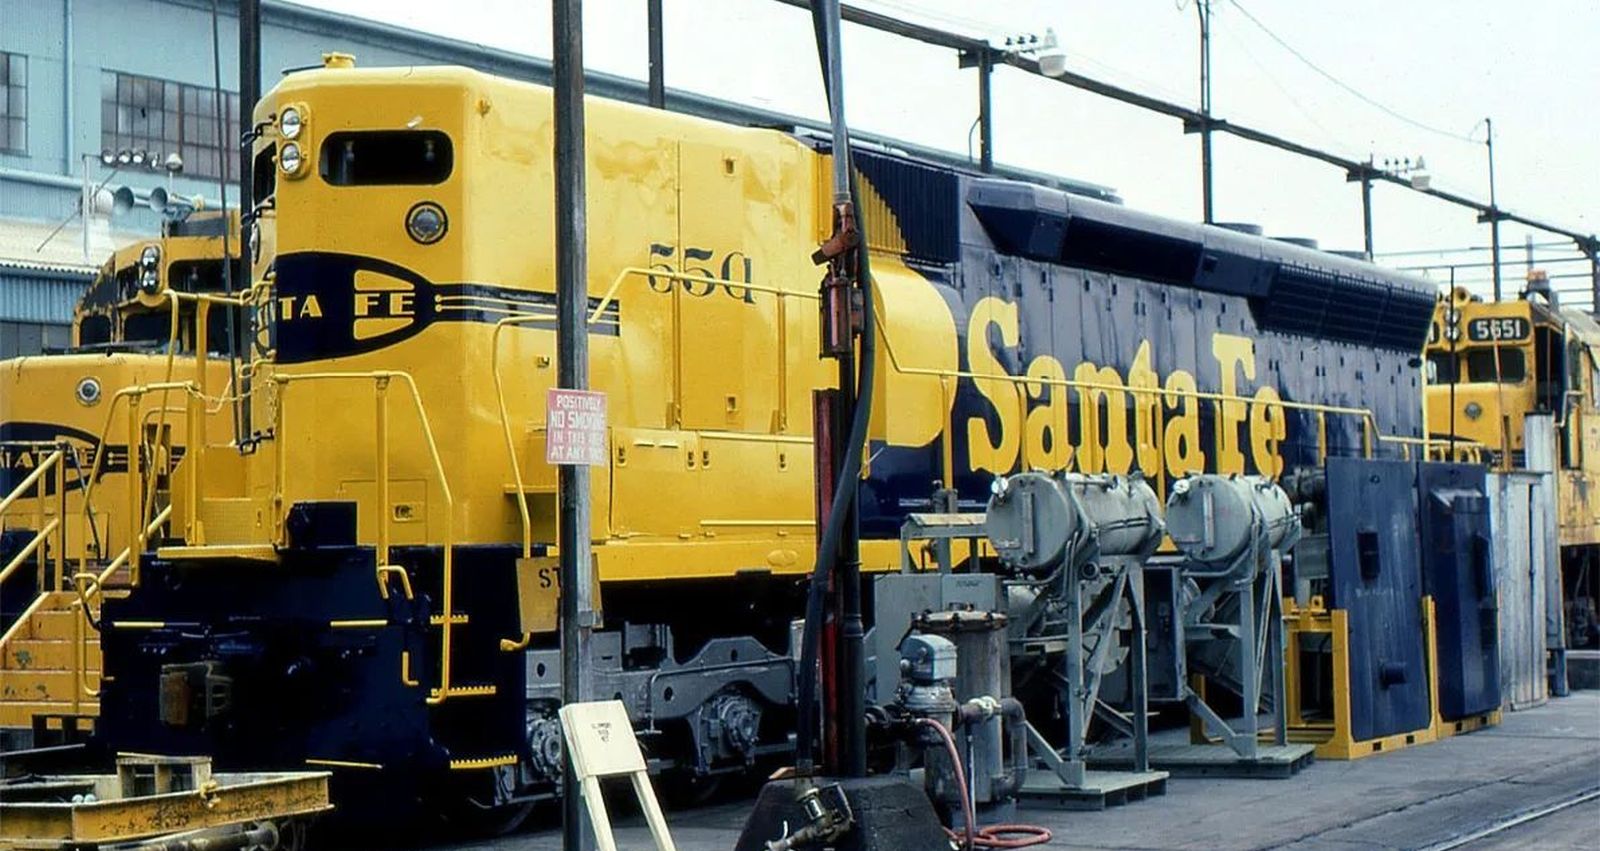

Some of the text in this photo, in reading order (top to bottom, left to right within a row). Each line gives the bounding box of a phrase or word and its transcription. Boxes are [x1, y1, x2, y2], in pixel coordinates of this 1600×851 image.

[354, 292, 416, 316] FE
[1475, 319, 1520, 339] 5651
[967, 296, 1286, 483] Santa Fe
[550, 409, 566, 429] NO
[553, 430, 564, 445] IN
[550, 446, 564, 460] AT
